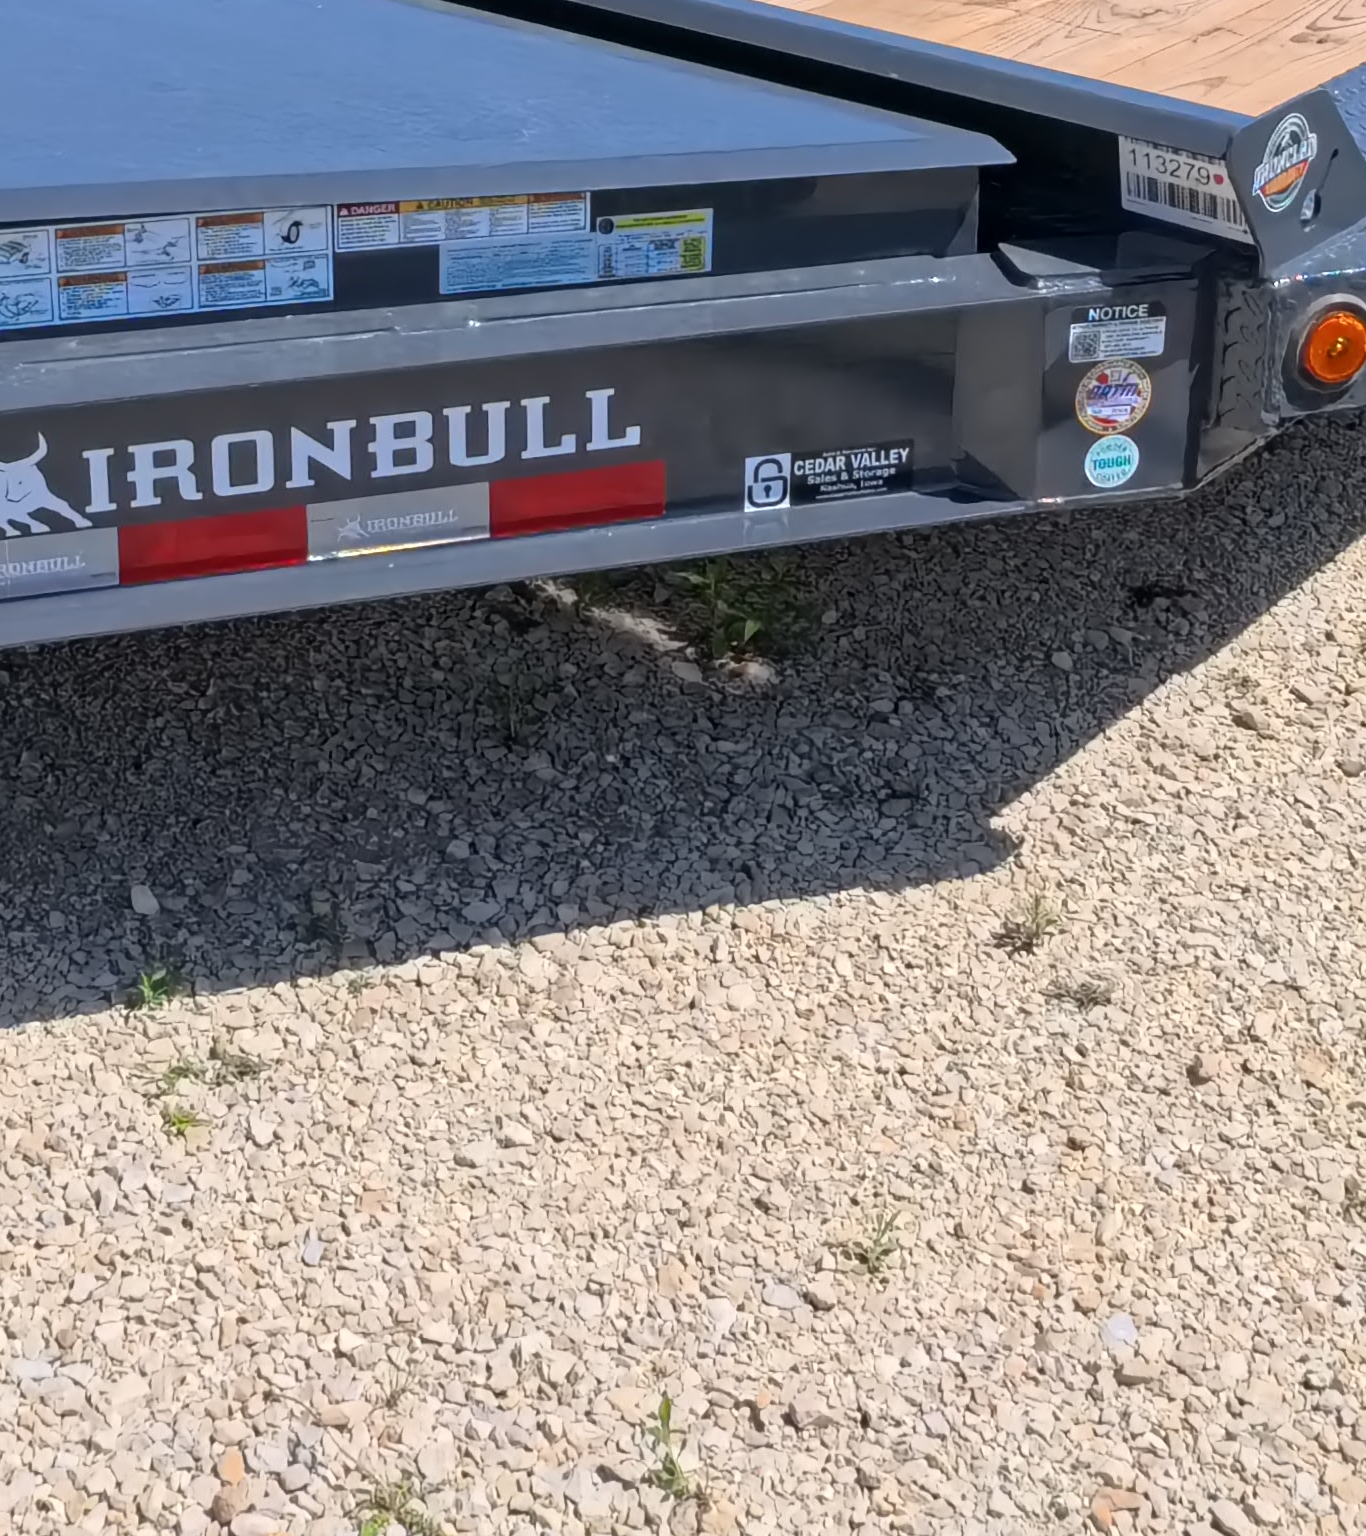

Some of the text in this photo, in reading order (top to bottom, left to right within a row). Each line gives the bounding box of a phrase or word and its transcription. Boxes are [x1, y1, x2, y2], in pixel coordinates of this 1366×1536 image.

[1128, 147, 1212, 187] 113279
[350, 203, 397, 216] DANGER
[426, 197, 475, 211] CAUTION
[1088, 304, 1149, 321] NOTICE
[82, 387, 643, 515] IRONBULL
[793, 455, 846, 477] CEDAR
[851, 447, 911, 469] VALLEY
[807, 466, 897, 485] Sales & Storage
